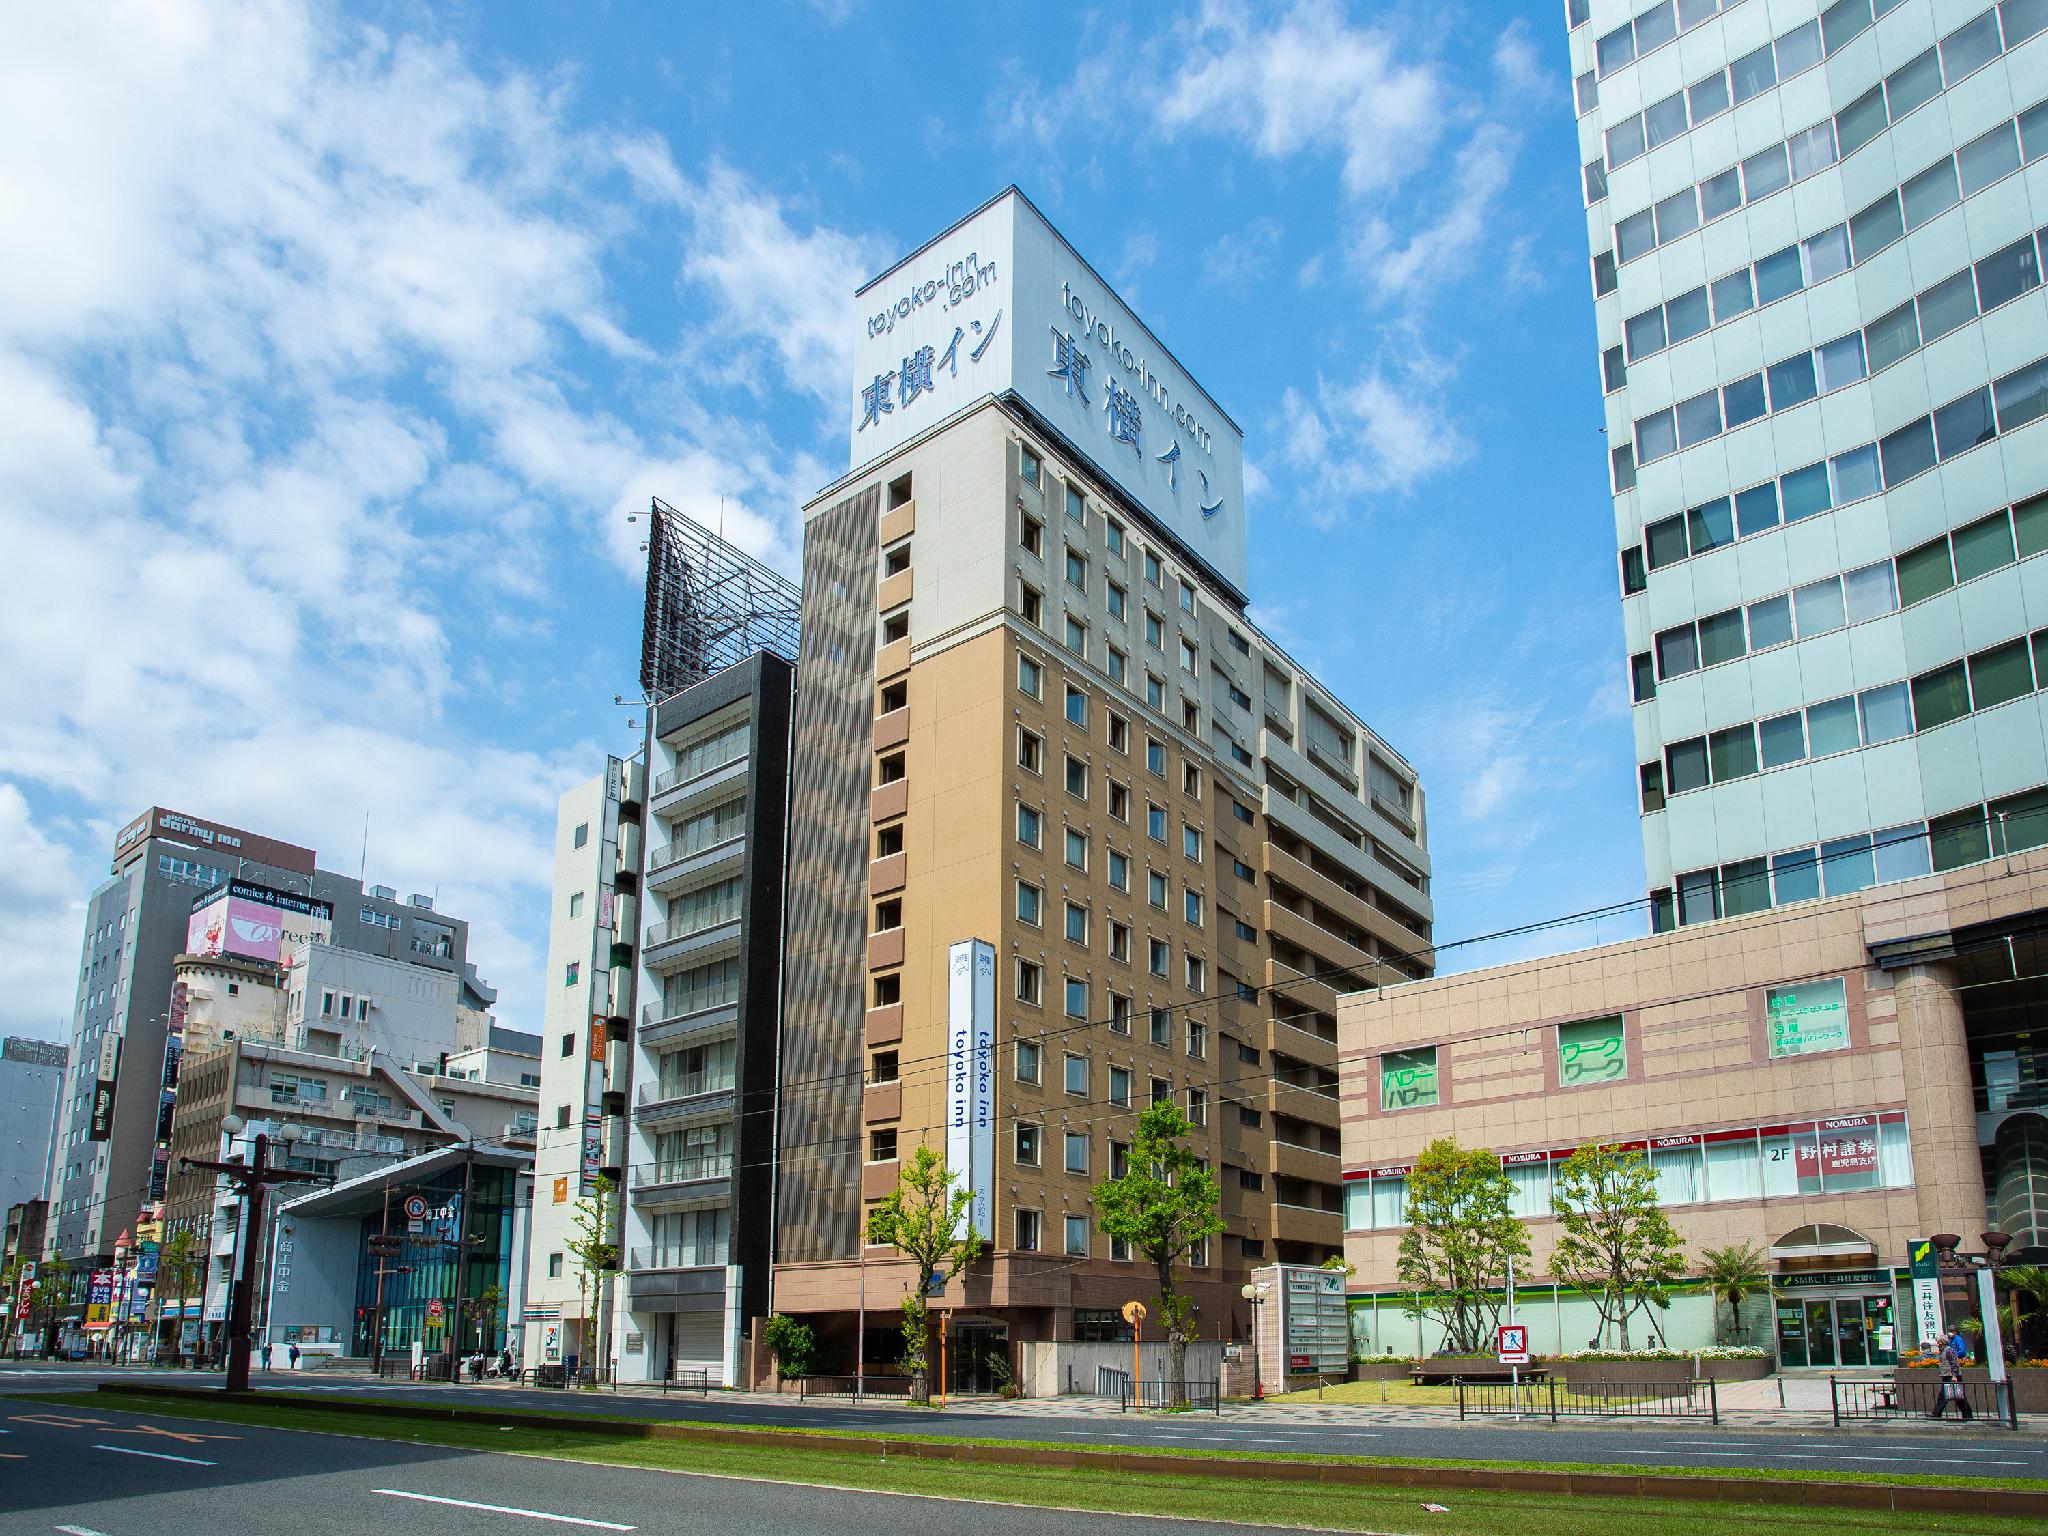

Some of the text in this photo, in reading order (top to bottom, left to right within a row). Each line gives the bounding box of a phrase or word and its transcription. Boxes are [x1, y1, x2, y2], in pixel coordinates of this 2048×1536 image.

[867, 251, 978, 338] toyoko-inn
[942, 260, 998, 312] .com
[857, 308, 1003, 432] 東横イン
[1062, 281, 1212, 455] toyoko-inn.com
[1046, 321, 1224, 521] 東横イン
[160, 815, 214, 845] dormy
[232, 885, 264, 899] comics
[266, 891, 275, 902] &
[276, 894, 310, 911] internet
[1563, 1037, 1621, 1063] ワーク
[955, 1028, 967, 1128] toyoko inn
[979, 1031, 989, 1128] toyoko inn
[1385, 1069, 1434, 1090] ハロー
[1825, 1117, 1868, 1129] NOMURA
[1657, 1136, 1694, 1148] NOMURA
[1770, 1148, 1790, 1162] 2F
[1800, 1139, 1876, 1161] 野村證券
[1376, 1166, 1407, 1177] NOMURA
[1508, 1153, 1541, 1164] NOMURA
[94, 1272, 112, 1285] 本
[276, 1240, 293, 1293] 商工中金
[1794, 1273, 1877, 1285] SMBC 三井住友銀行
[1921, 1281, 1937, 1340] 三井住友銀行
